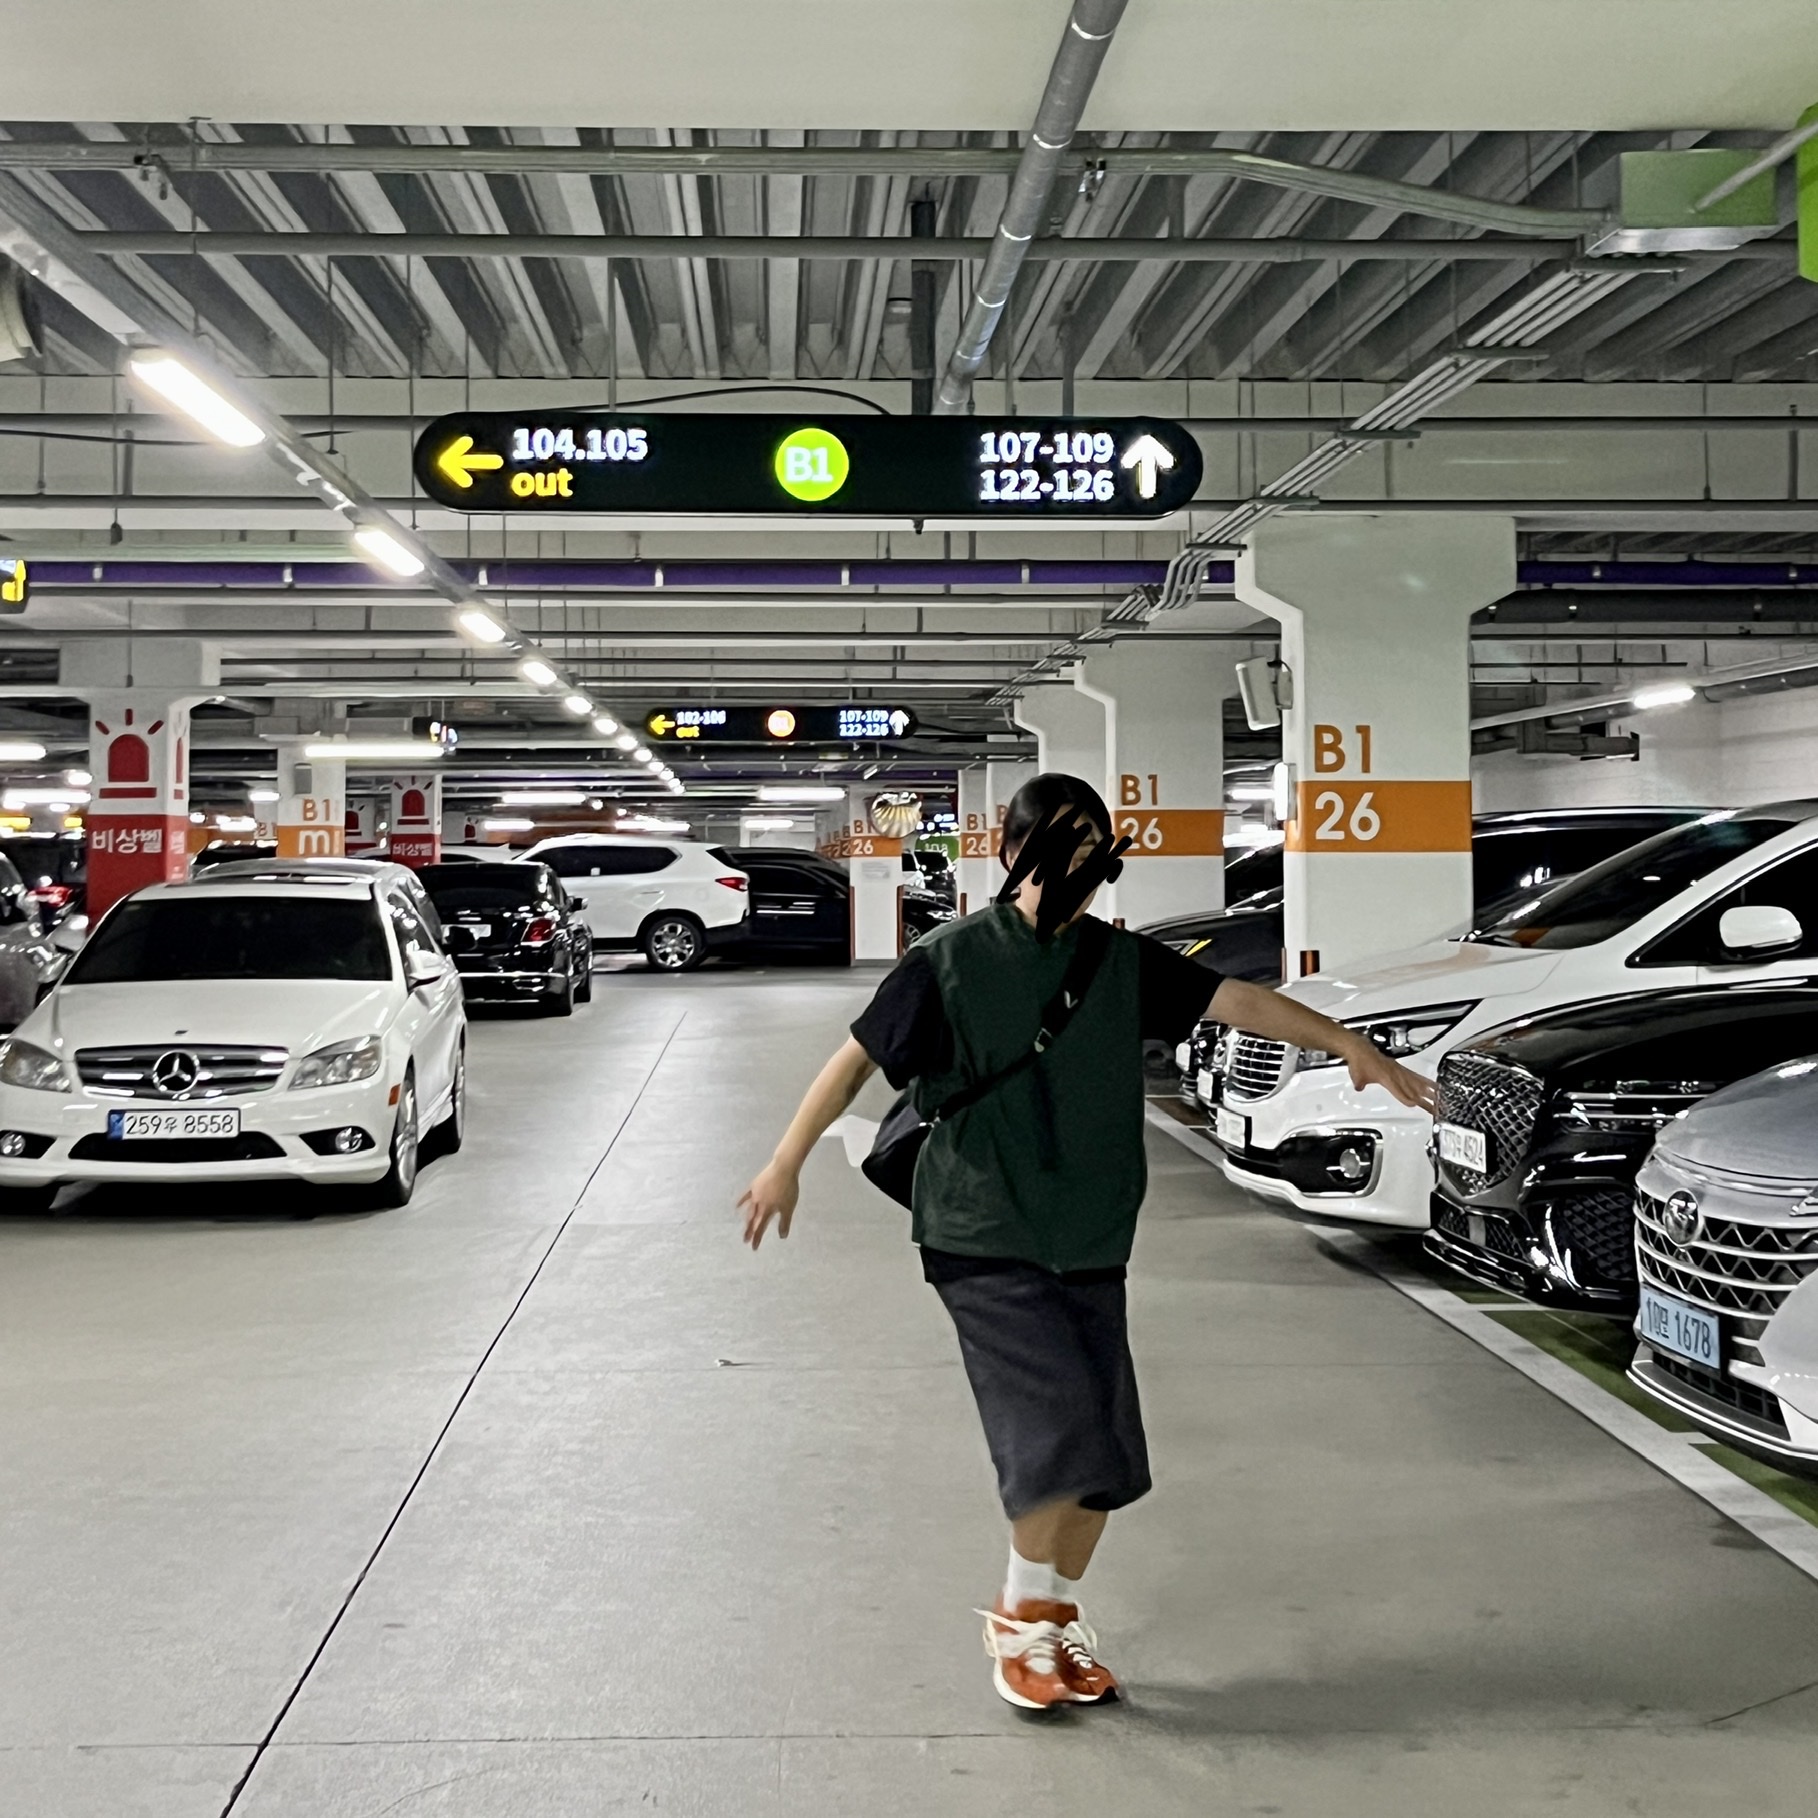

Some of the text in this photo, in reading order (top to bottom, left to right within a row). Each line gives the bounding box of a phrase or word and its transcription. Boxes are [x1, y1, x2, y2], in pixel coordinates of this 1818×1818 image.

[513, 428, 648, 460] 104.105
[980, 432, 1114, 463] 107-109
[785, 446, 834, 483] B1
[511, 467, 574, 497] out
[980, 469, 1114, 500] 122-126
[1314, 724, 1372, 774] B1
[1120, 774, 1158, 806] B1
[302, 798, 330, 821] B1
[1314, 791, 1381, 841] 26
[92, 829, 162, 853] 비상벨
[853, 838, 874, 855] 26
[1120, 817, 1163, 850] 26
[184, 1114, 234, 1134] 8558
[1675, 1311, 1711, 1359] 1678
